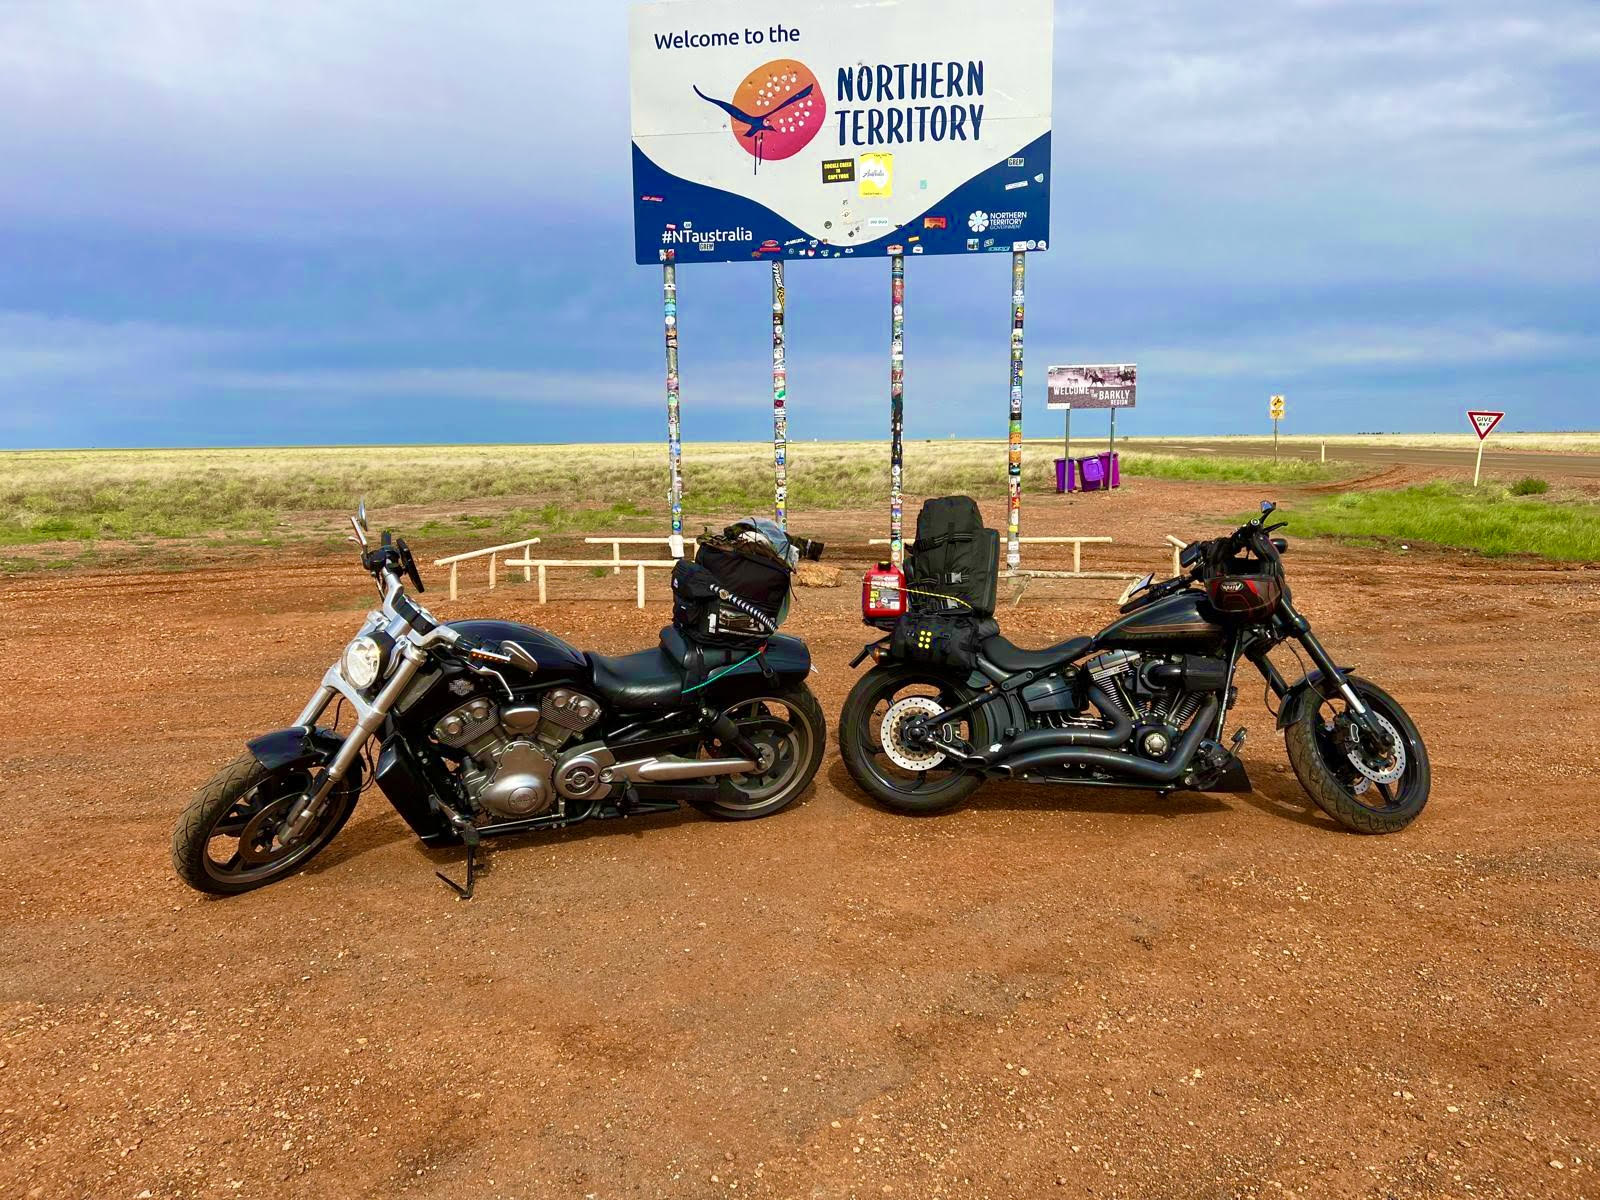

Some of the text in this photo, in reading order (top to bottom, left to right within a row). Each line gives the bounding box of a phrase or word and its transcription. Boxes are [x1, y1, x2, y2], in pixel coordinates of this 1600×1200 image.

[654, 24, 800, 50] Welcome to the
[837, 60, 984, 102] NORTHERN
[834, 103, 984, 146] TERRITORY
[990, 211, 1027, 219] NORTHERN
[990, 218, 1023, 226] TERRITORY
[662, 226, 752, 244] #NTaustralia
[1053, 386, 1090, 395] WELCOME
[1099, 390, 1130, 400] BARKLY
